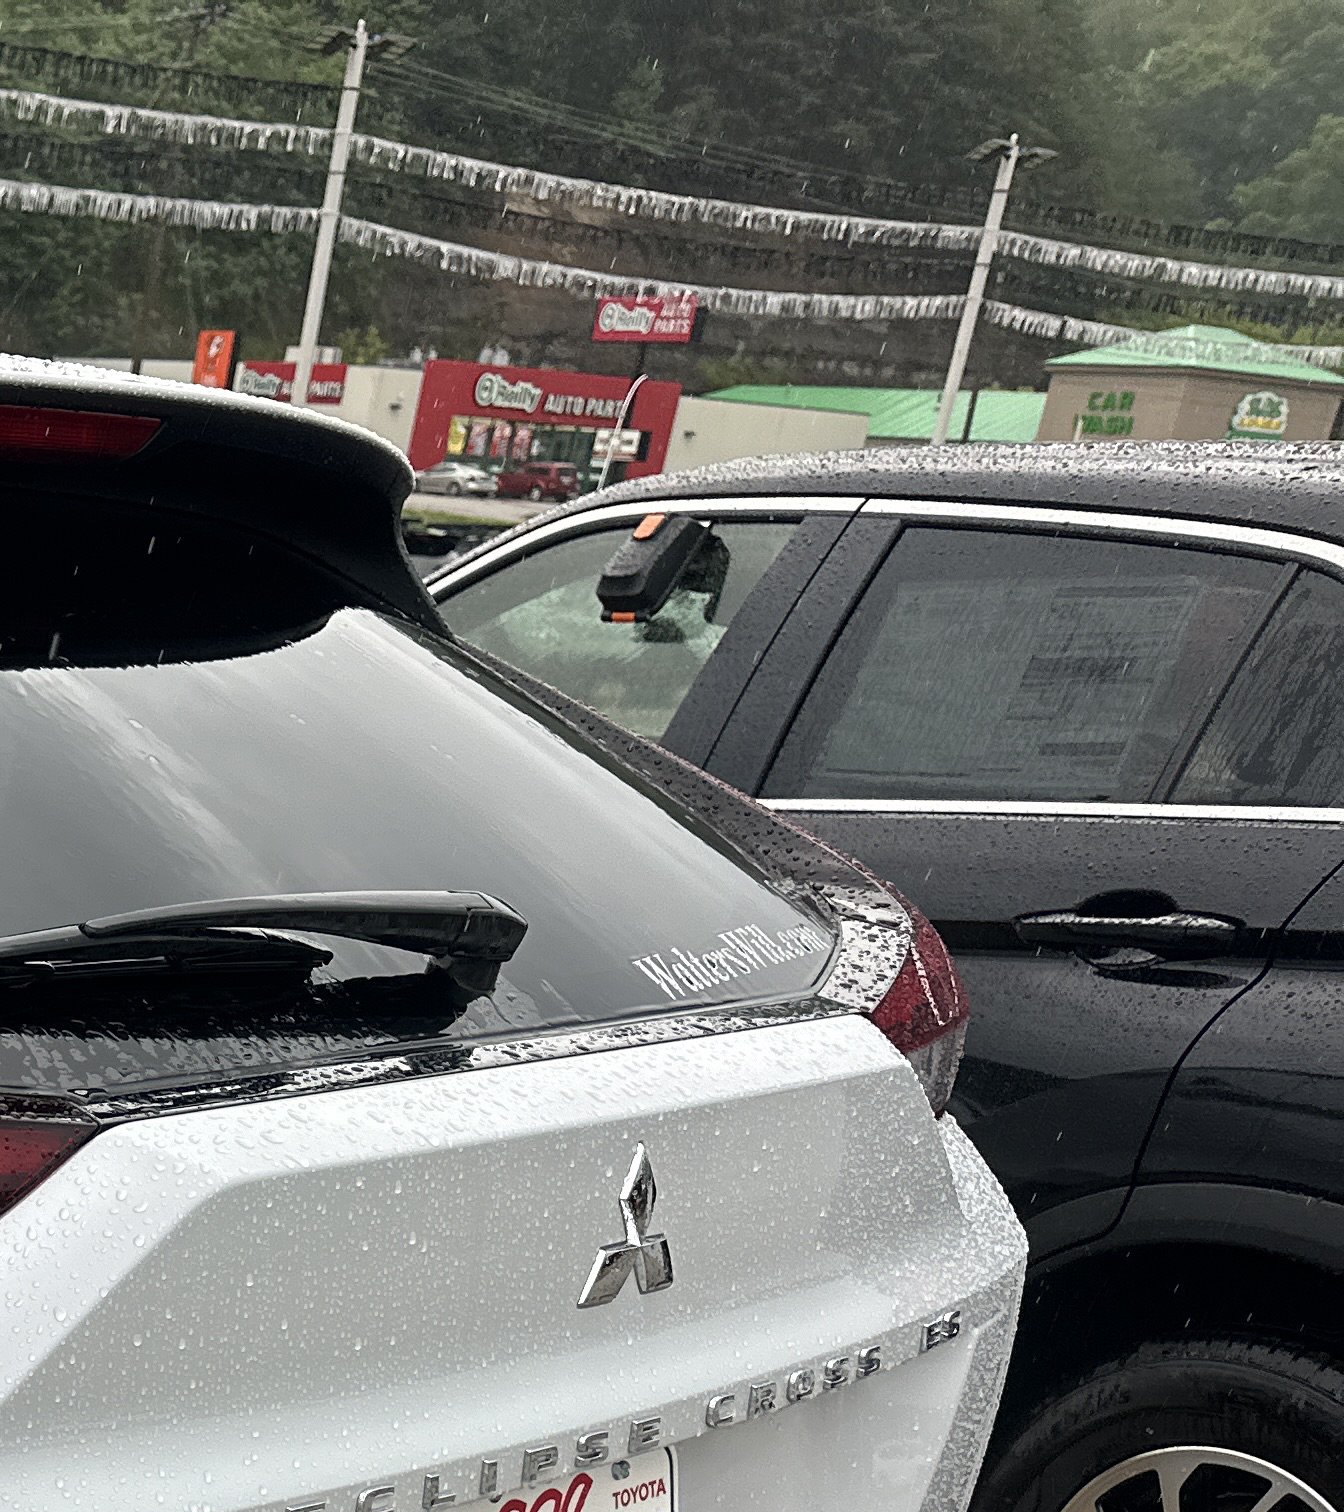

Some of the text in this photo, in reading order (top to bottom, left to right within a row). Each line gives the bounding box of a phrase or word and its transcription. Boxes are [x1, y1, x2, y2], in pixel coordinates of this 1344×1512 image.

[653, 318, 691, 334] PARTS
[544, 393, 584, 416] AUTO
[585, 398, 628, 419] PART
[1087, 391, 1135, 411] CAR
[705, 1345, 881, 1428] CROSS
[921, 1310, 961, 1351] ES
[613, 1477, 667, 1510] TOYOTA
